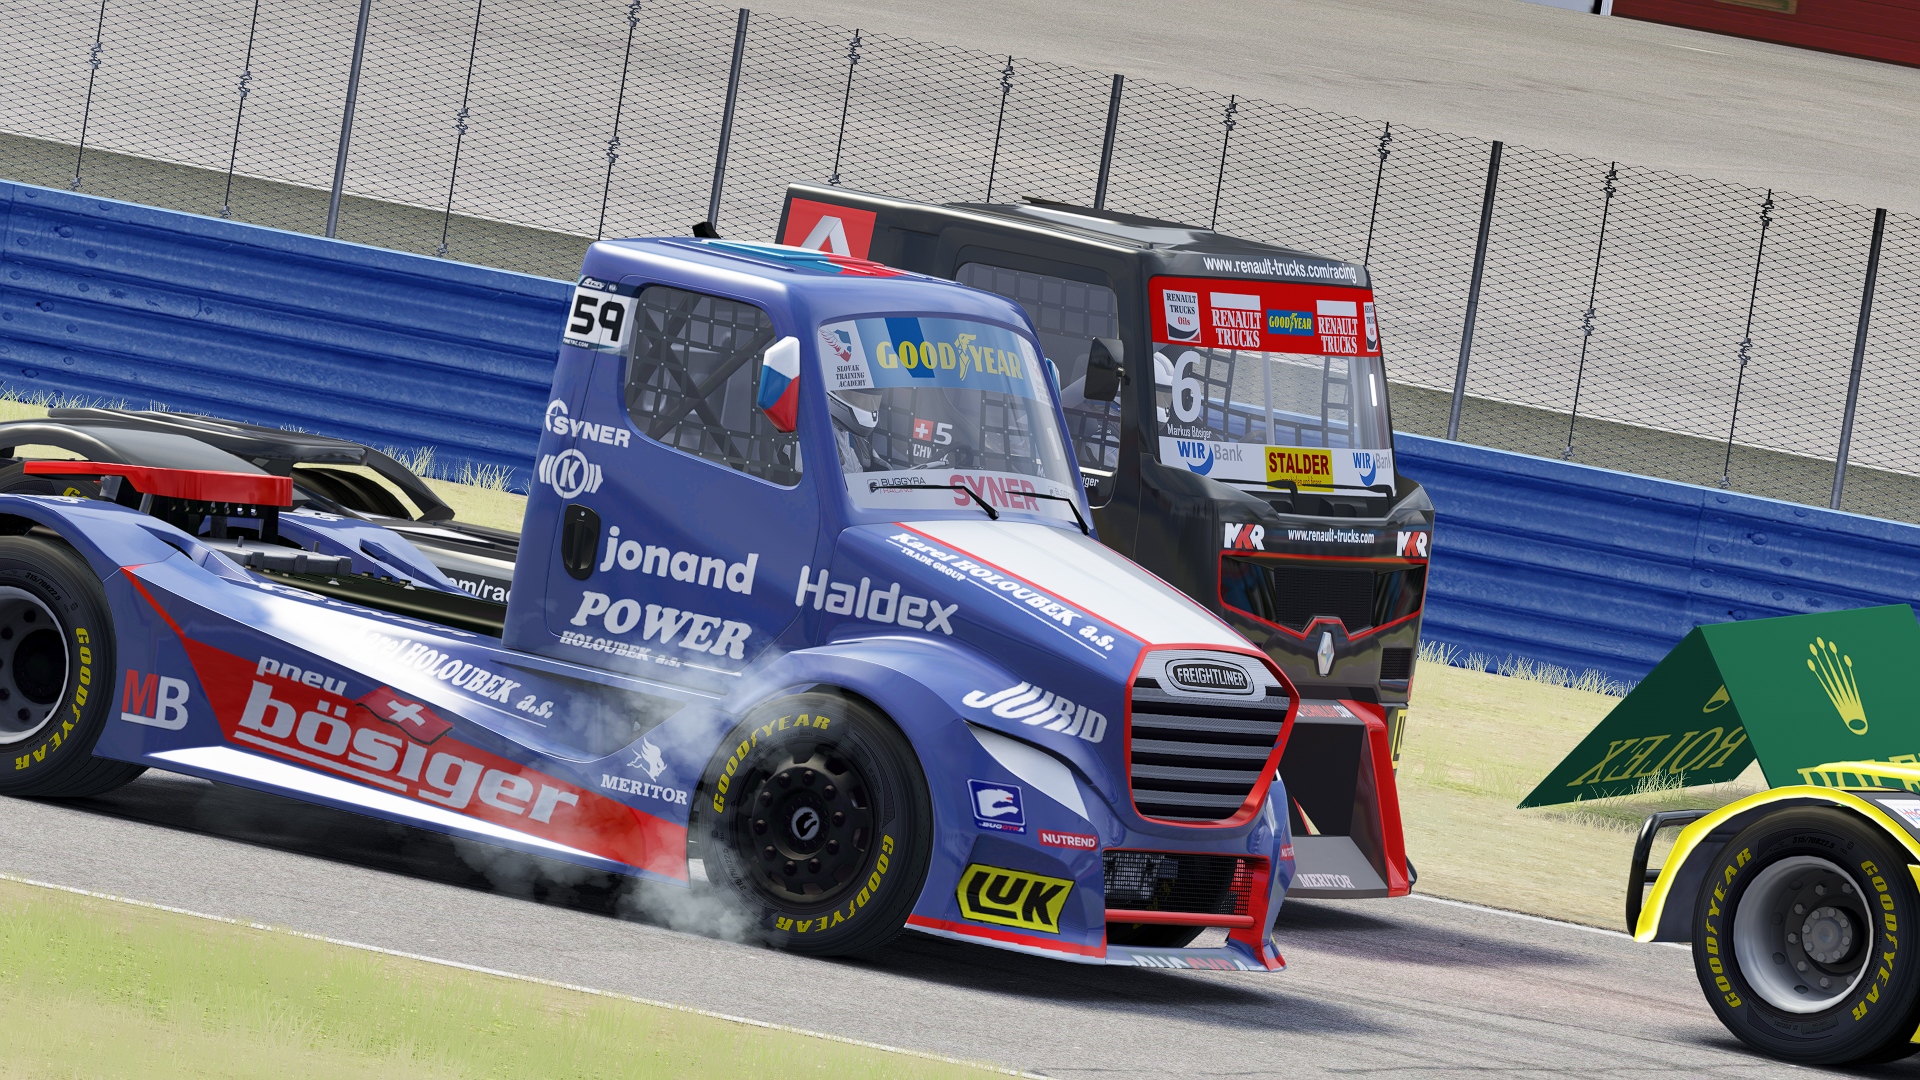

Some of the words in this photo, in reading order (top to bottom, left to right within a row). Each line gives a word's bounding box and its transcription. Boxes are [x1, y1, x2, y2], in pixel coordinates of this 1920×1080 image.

[1203, 257, 1356, 283] www.renault-trucks.com/racing
[1166, 293, 1196, 304] RENAULT
[1169, 304, 1195, 315] TRUCKS
[570, 295, 625, 342] 59
[1178, 316, 1190, 326] Oils
[1211, 309, 1261, 330] RENAULT
[1269, 313, 1312, 333] GOODYEAR
[1317, 316, 1358, 336] RENAULT
[1215, 328, 1260, 348] TRUCKS
[1321, 335, 1358, 355] TRUCKS
[837, 365, 860, 373] SLOVAK
[876, 334, 1023, 381] GOODYEAR
[836, 372, 865, 380] TRAINING
[839, 380, 867, 388] ACADEMY
[553, 416, 631, 448] SYNER
[1167, 423, 1191, 437] Markus
[1177, 440, 1206, 459] WIR
[1213, 443, 1243, 462] Bank
[1269, 452, 1330, 475] STALDER
[1352, 452, 1371, 469] WIR
[1376, 453, 1392, 469] Bank
[949, 474, 1040, 512] SYNER
[1224, 522, 1265, 550] MKR
[1288, 528, 1375, 544] www.renault-trucks.com
[1396, 531, 1427, 557] MKR
[599, 525, 759, 595] jonand
[901, 547, 934, 567] TRADE
[933, 561, 966, 581] GROUP
[795, 565, 959, 635] Haldex
[890, 532, 959, 567] Karel
[951, 557, 1082, 627] HOLOUBEK
[1079, 625, 1114, 651] a.s.
[570, 591, 752, 660] POWER
[559, 631, 652, 661] HOLOUBEK
[256, 655, 347, 697] pneu
[403, 642, 521, 704] HOLOUBEK
[516, 695, 554, 719] a.s.
[1177, 668, 1246, 687] FREIGHTLINER
[14, 628, 92, 770] GOODYEAR
[121, 668, 190, 730] MB
[962, 681, 1108, 743] JURID
[237, 679, 579, 824] bösiger
[714, 713, 831, 814] GOODYEAR
[601, 774, 688, 805] MERITOR
[1042, 833, 1096, 848] NUTREND
[776, 835, 894, 933] GOODYEAR
[1297, 873, 1355, 889] MERITOR
[1705, 848, 1752, 1008] GOODYEAR
[1851, 860, 1897, 1021] GOODYEAR
